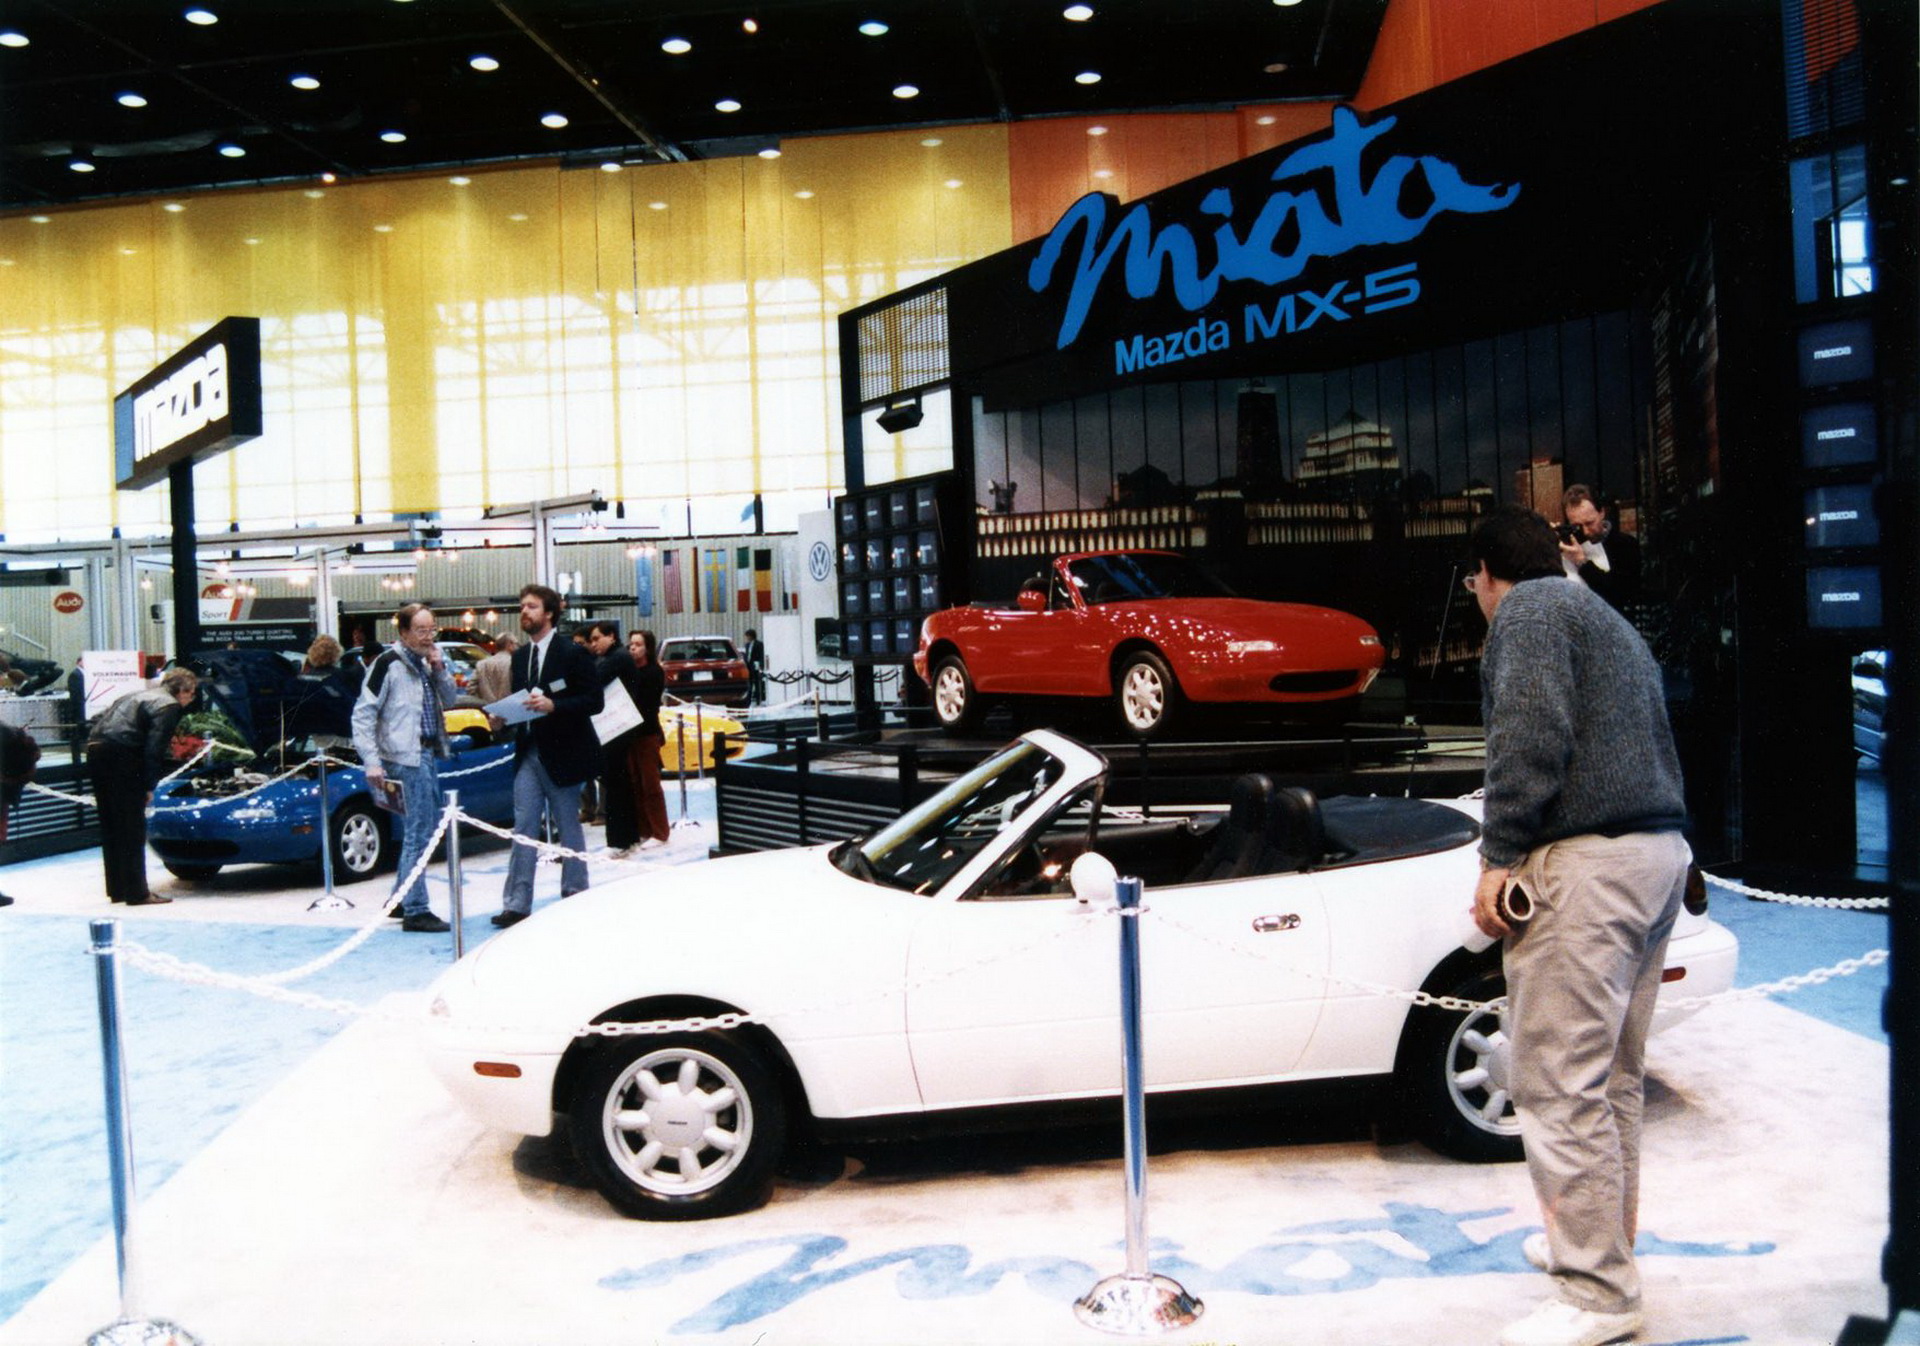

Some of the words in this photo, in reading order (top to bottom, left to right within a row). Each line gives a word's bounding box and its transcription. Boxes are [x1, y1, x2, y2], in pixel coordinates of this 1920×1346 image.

[1028, 105, 1521, 350] Miata
[1115, 318, 1230, 375] Mazda
[1244, 262, 1422, 344] MX-5
[1813, 346, 1852, 359] mazda
[133, 343, 229, 463] mazda
[1817, 427, 1856, 440] mazda
[1819, 510, 1858, 521] mazda
[1821, 592, 1860, 602] mazda
